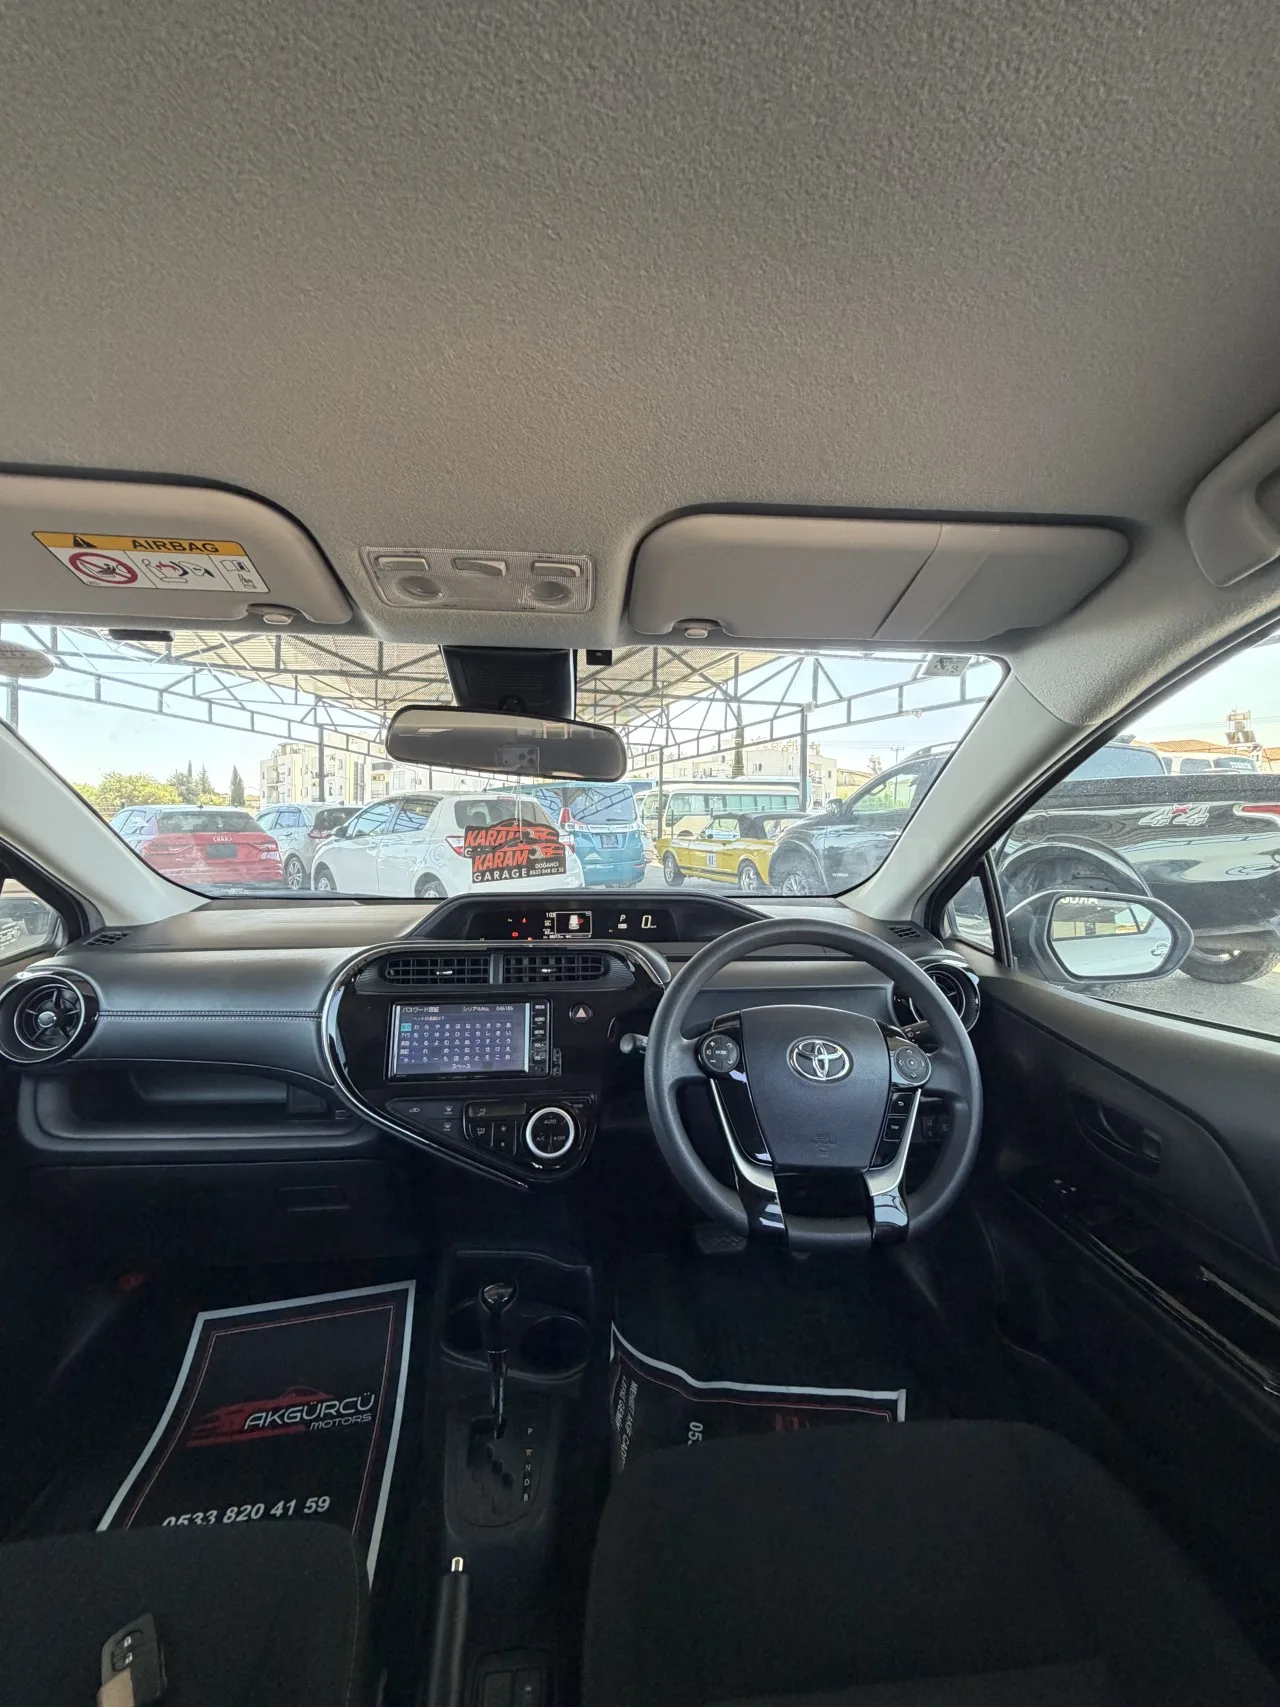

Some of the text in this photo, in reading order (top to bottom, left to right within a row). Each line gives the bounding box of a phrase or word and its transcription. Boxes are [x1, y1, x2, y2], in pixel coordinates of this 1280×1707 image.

[132, 538, 219, 554] AIRBAG
[473, 850, 528, 872] KARAM
[473, 868, 528, 881] GARAGE
[619, 914, 626, 922] P
[641, 914, 651, 929] 0
[243, 1392, 375, 1430] AKGÜRCÜ
[309, 1414, 372, 1431] MOTORS
[527, 1427, 533, 1435] P
[524, 1478, 530, 1486] D
[223, 1503, 265, 1524] 820
[270, 1499, 297, 1517] 41
[304, 1496, 331, 1513] 59
